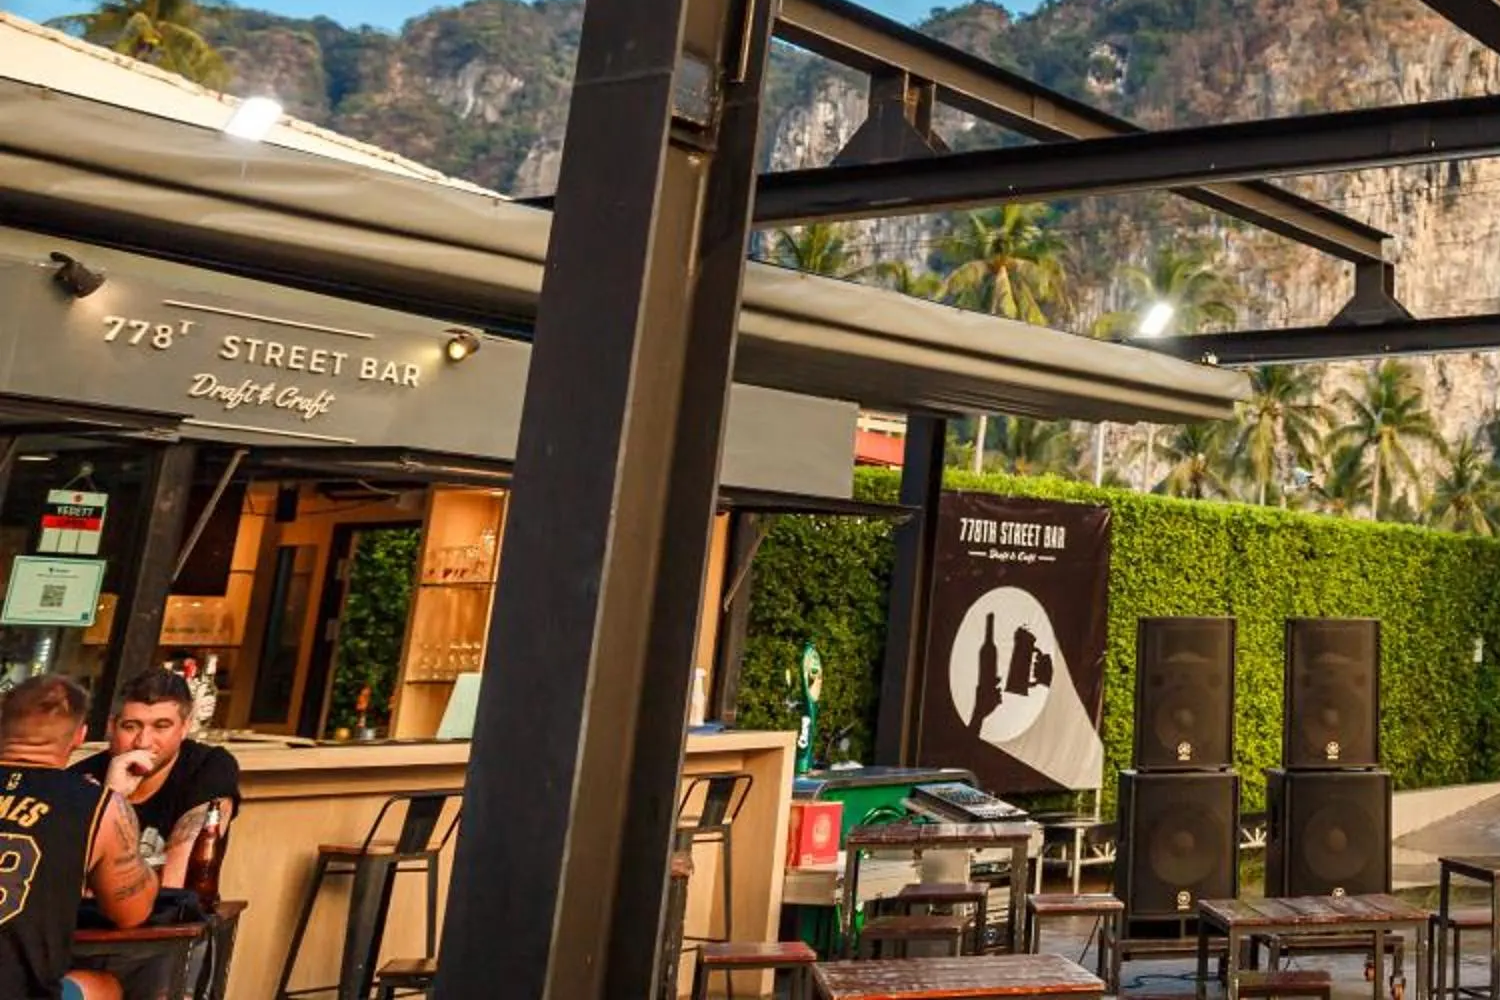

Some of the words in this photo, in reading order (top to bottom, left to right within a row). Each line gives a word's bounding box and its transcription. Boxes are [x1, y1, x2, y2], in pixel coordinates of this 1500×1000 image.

[220, 335, 348, 376] STREET
[359, 356, 421, 388] BAR
[189, 373, 259, 409] Draft
[276, 386, 336, 419] Craft
[960, 517, 997, 544] 778TH
[1000, 521, 1042, 547] STREET
[1044, 525, 1065, 549] BAR
